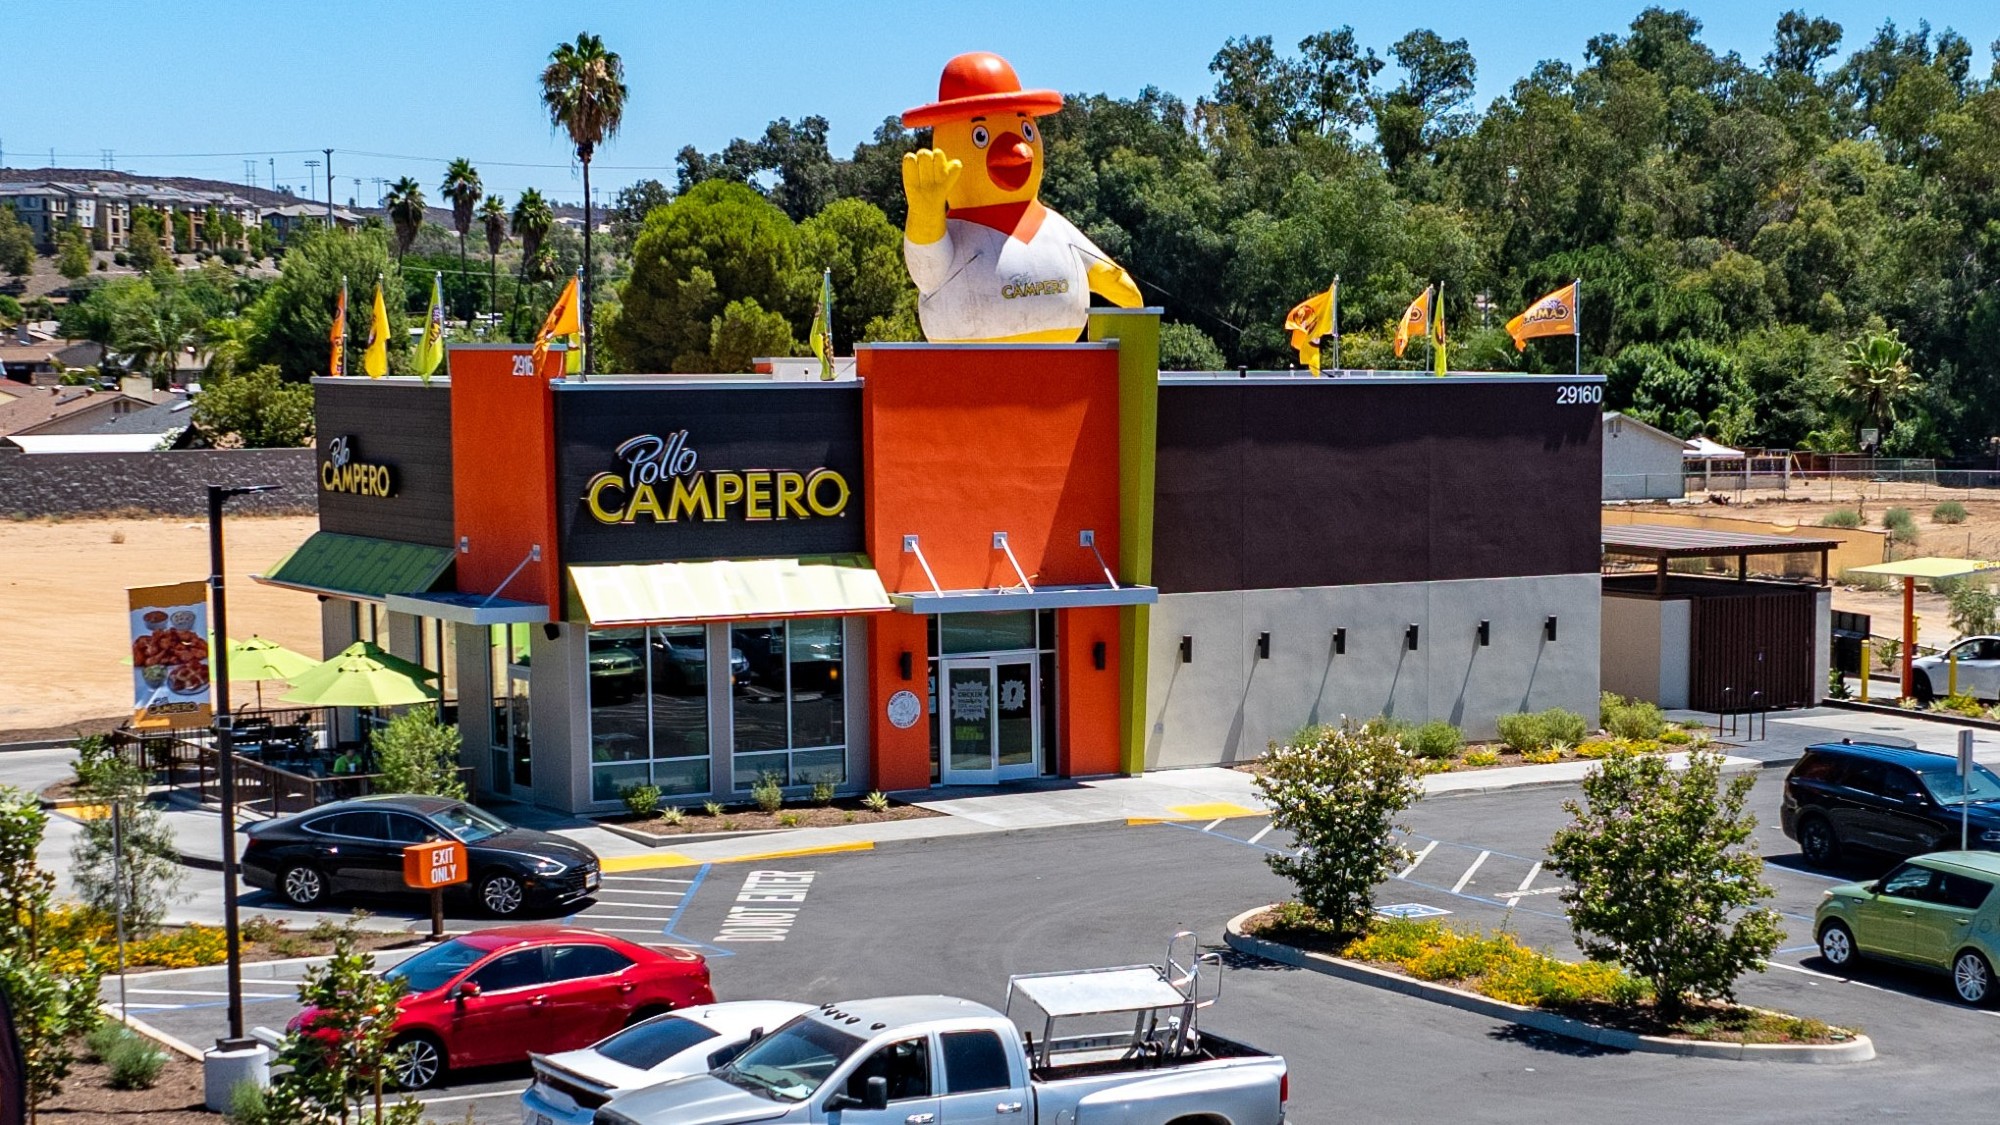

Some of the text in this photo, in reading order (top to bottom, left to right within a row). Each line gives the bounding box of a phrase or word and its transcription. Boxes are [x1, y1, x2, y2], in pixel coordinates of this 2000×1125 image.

[1002, 279, 1069, 299] CAMPERO
[1556, 386, 1602, 404] 29160
[617, 429, 698, 488] Pollo
[322, 461, 390, 497] CAMPERO
[584, 468, 850, 525] CAMPERO
[432, 847, 455, 867] EXIT
[431, 864, 457, 884] ONLY
[713, 870, 816, 942] DO NOT ENTER
